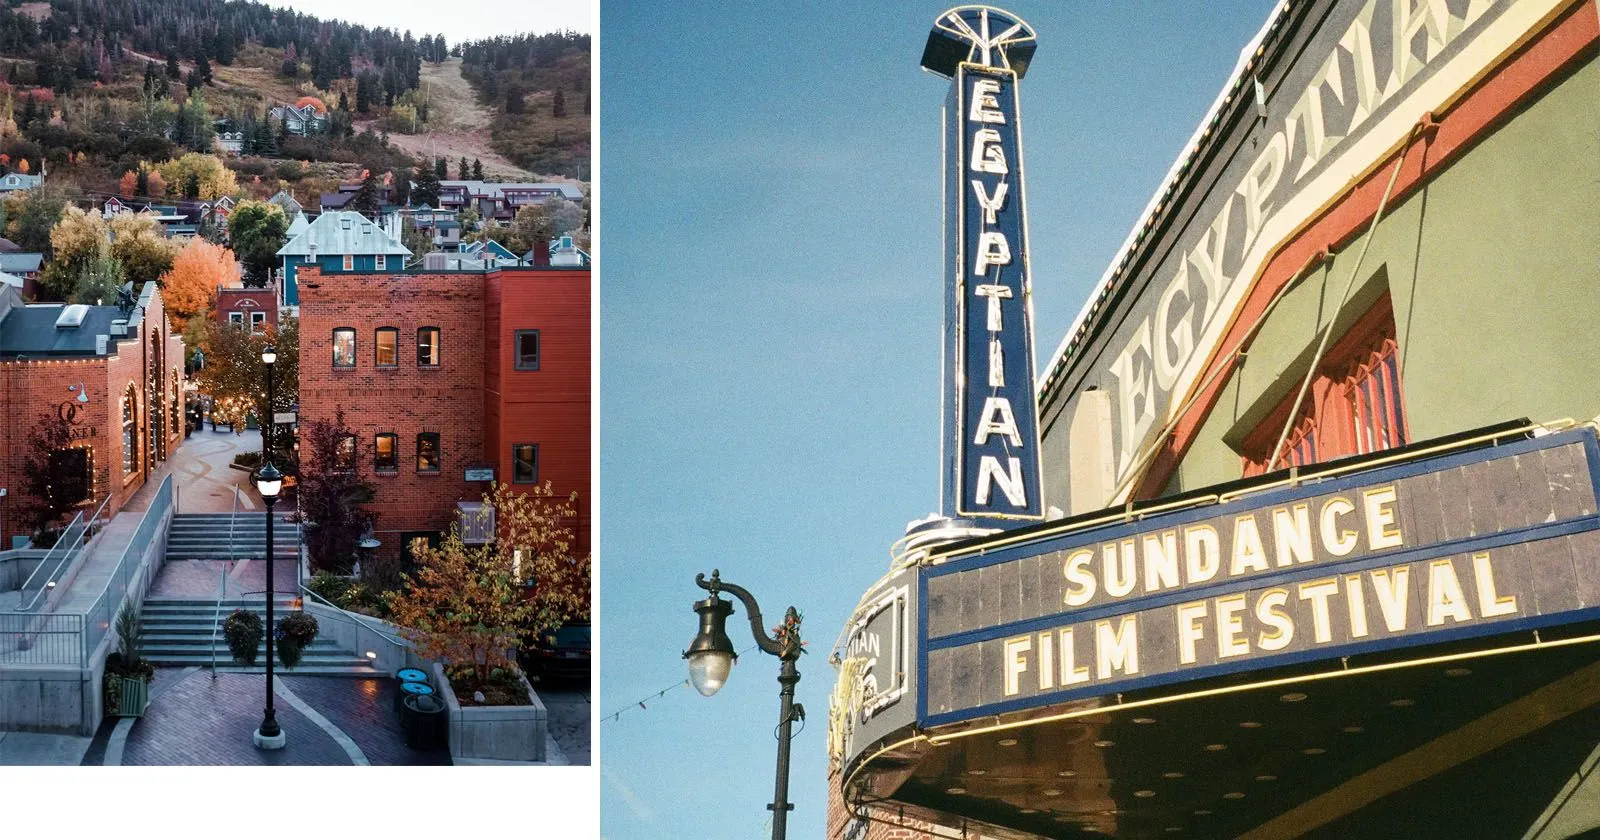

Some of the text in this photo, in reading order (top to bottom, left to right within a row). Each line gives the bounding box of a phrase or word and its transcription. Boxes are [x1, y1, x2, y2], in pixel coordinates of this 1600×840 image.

[969, 78, 1028, 508] EGYPTIAN
[1110, 0, 1500, 484] EGYPTIA
[1004, 551, 1518, 697] FILM FESTIVAL
[1063, 485, 1403, 606] SUNDANCE
